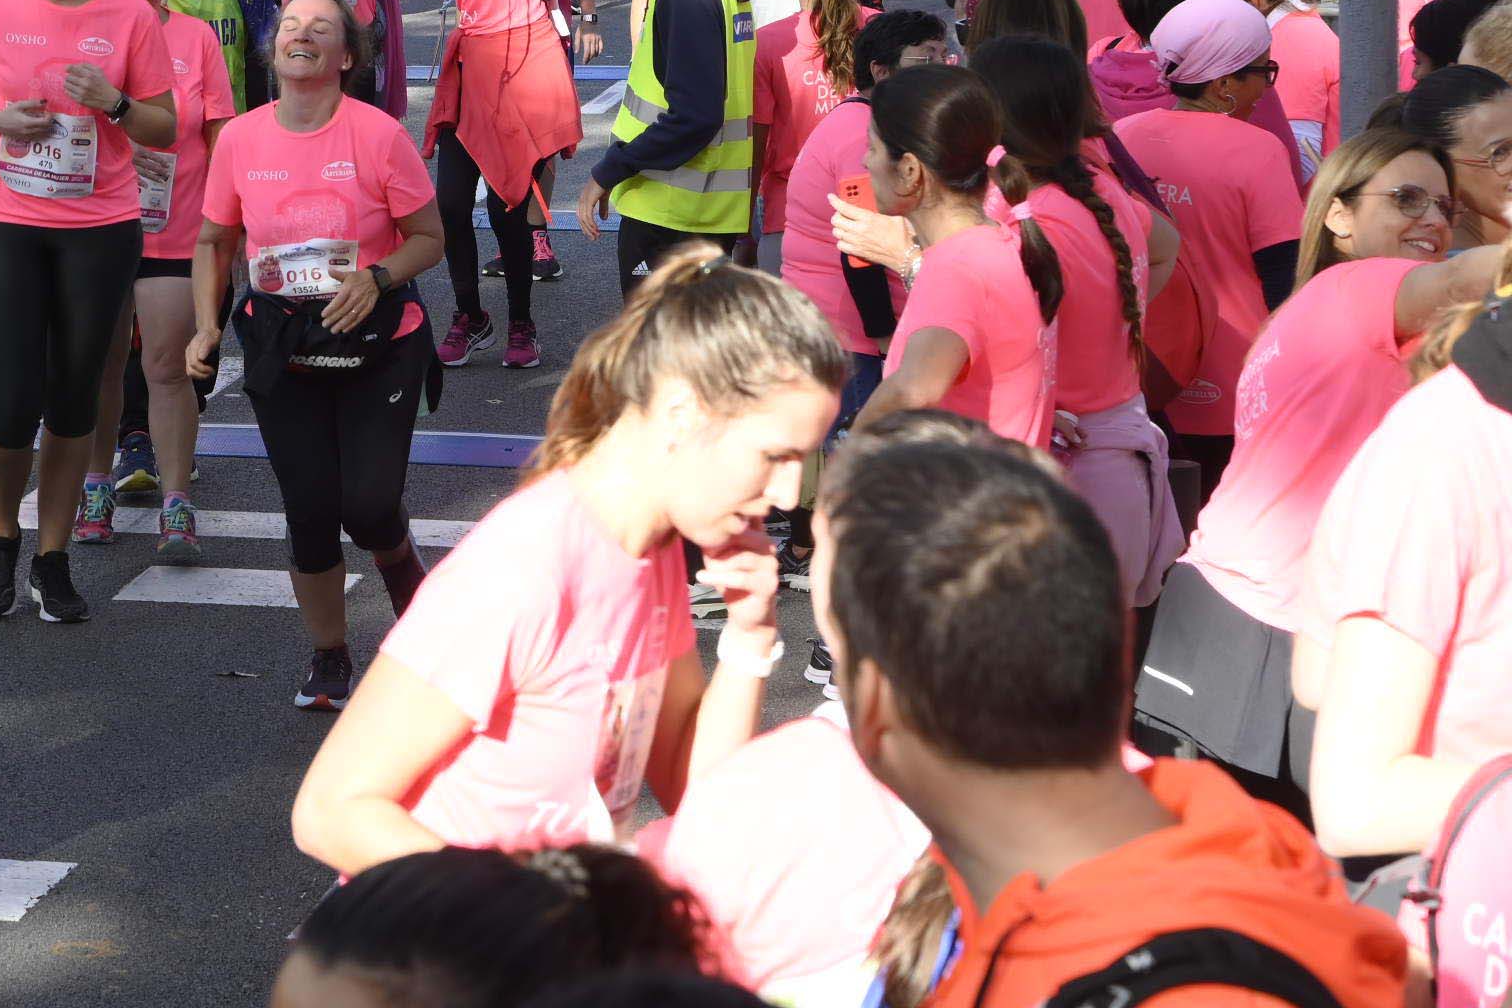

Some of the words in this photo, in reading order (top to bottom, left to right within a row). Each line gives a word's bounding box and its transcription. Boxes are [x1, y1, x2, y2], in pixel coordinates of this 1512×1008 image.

[5, 32, 47, 47] OYSHO
[33, 142, 62, 160] 016
[38, 159, 53, 170] 479
[247, 170, 288, 182] OYSHO
[286, 267, 322, 284] 016
[292, 284, 320, 295] 13524
[530, 800, 587, 834] TU
